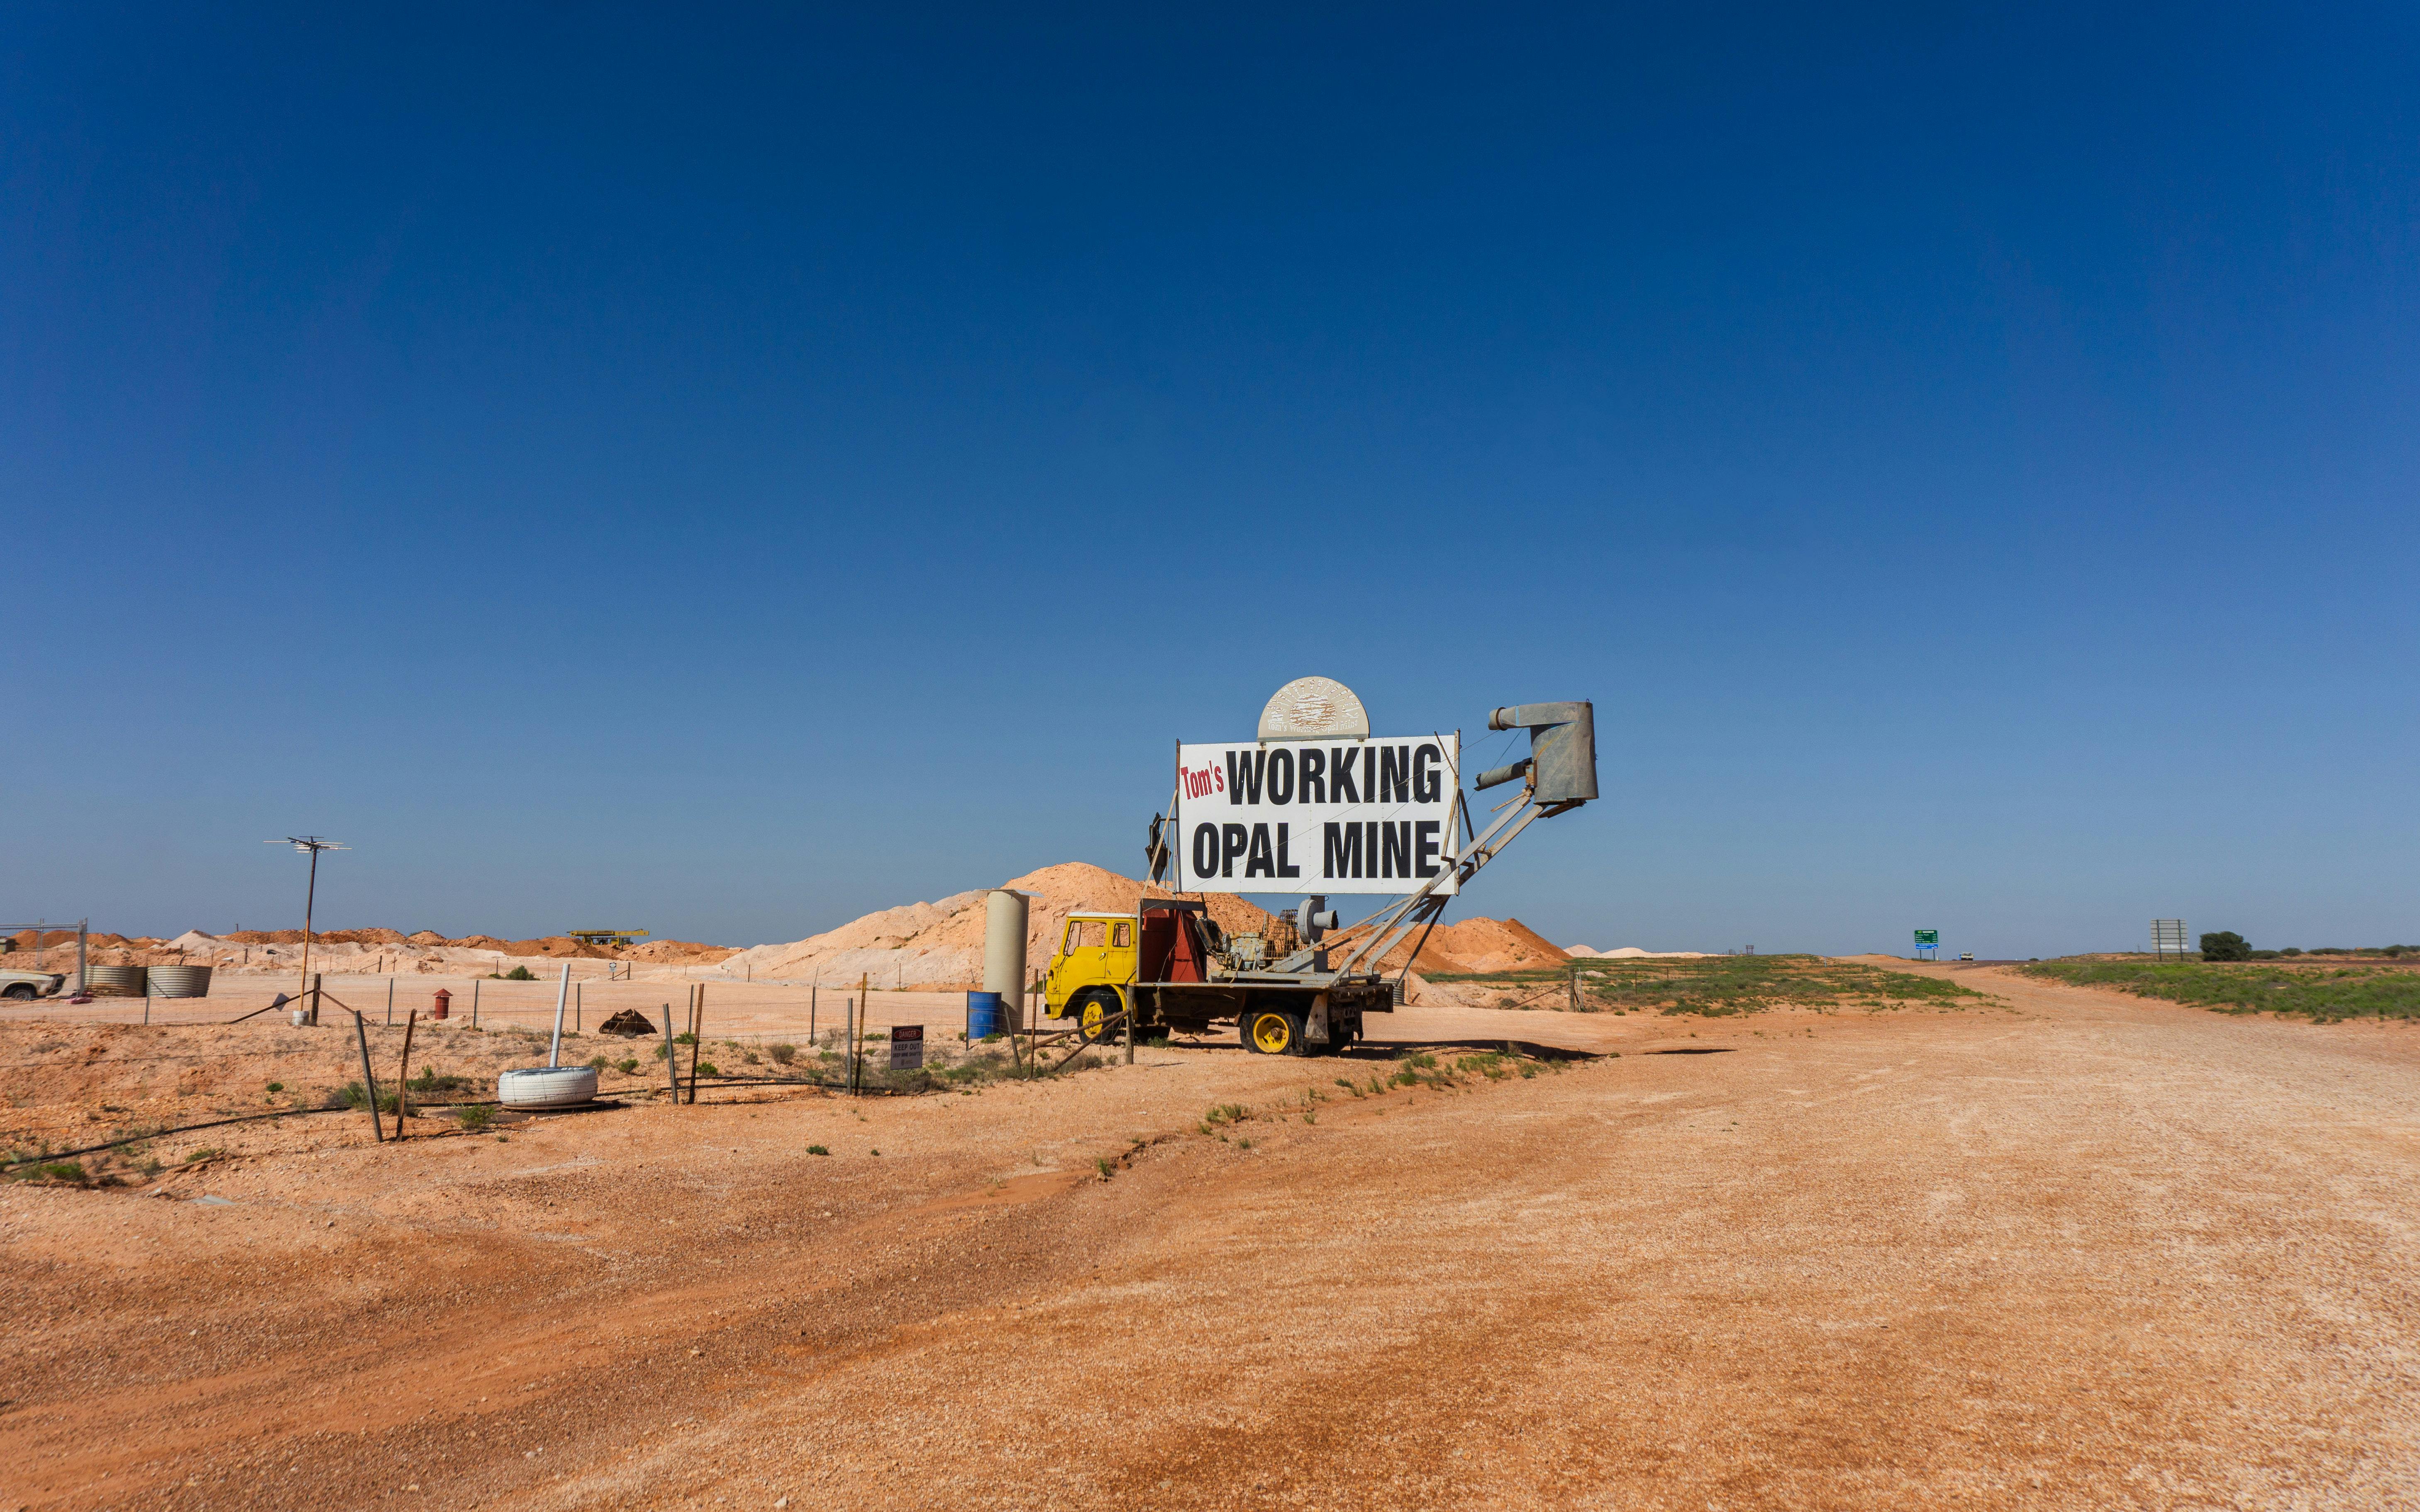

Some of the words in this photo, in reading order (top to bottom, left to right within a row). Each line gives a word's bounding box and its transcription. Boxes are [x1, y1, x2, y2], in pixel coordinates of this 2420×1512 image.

[1268, 719, 1287, 732] Tom's
[1180, 760, 1224, 800] Tom's
[1226, 744, 1441, 805] WORKING
[1193, 823, 1300, 879] OPAL
[1323, 821, 1441, 878] MINE
